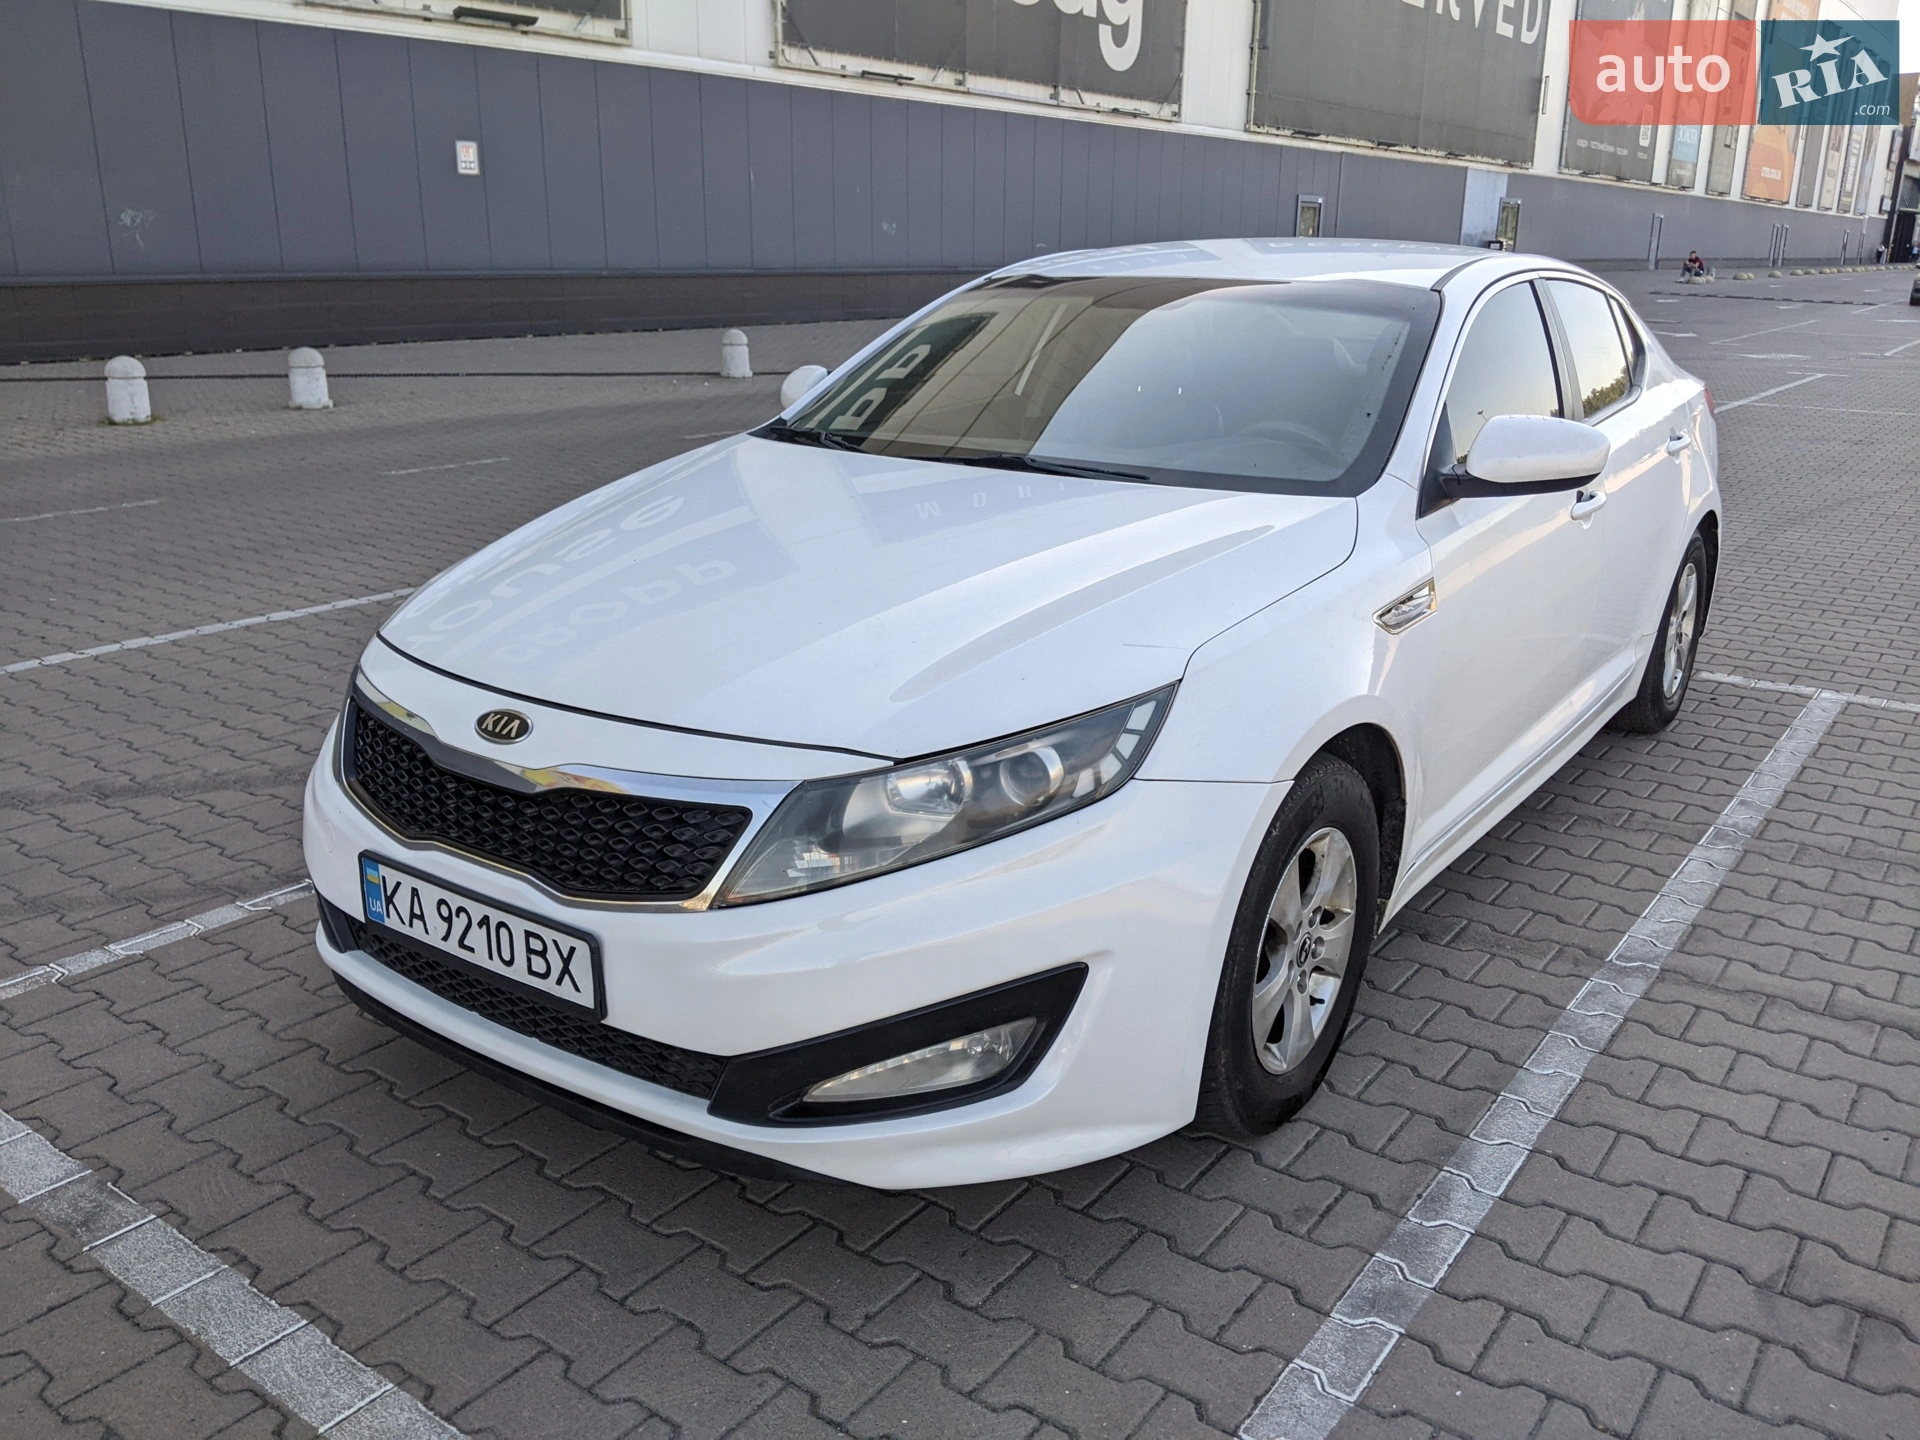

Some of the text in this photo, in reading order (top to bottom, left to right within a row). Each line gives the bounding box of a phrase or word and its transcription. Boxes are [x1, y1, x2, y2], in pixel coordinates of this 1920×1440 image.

[480, 712, 523, 739] KIA
[369, 896, 384, 915] UA
[380, 874, 583, 994] KA 9210 BX
